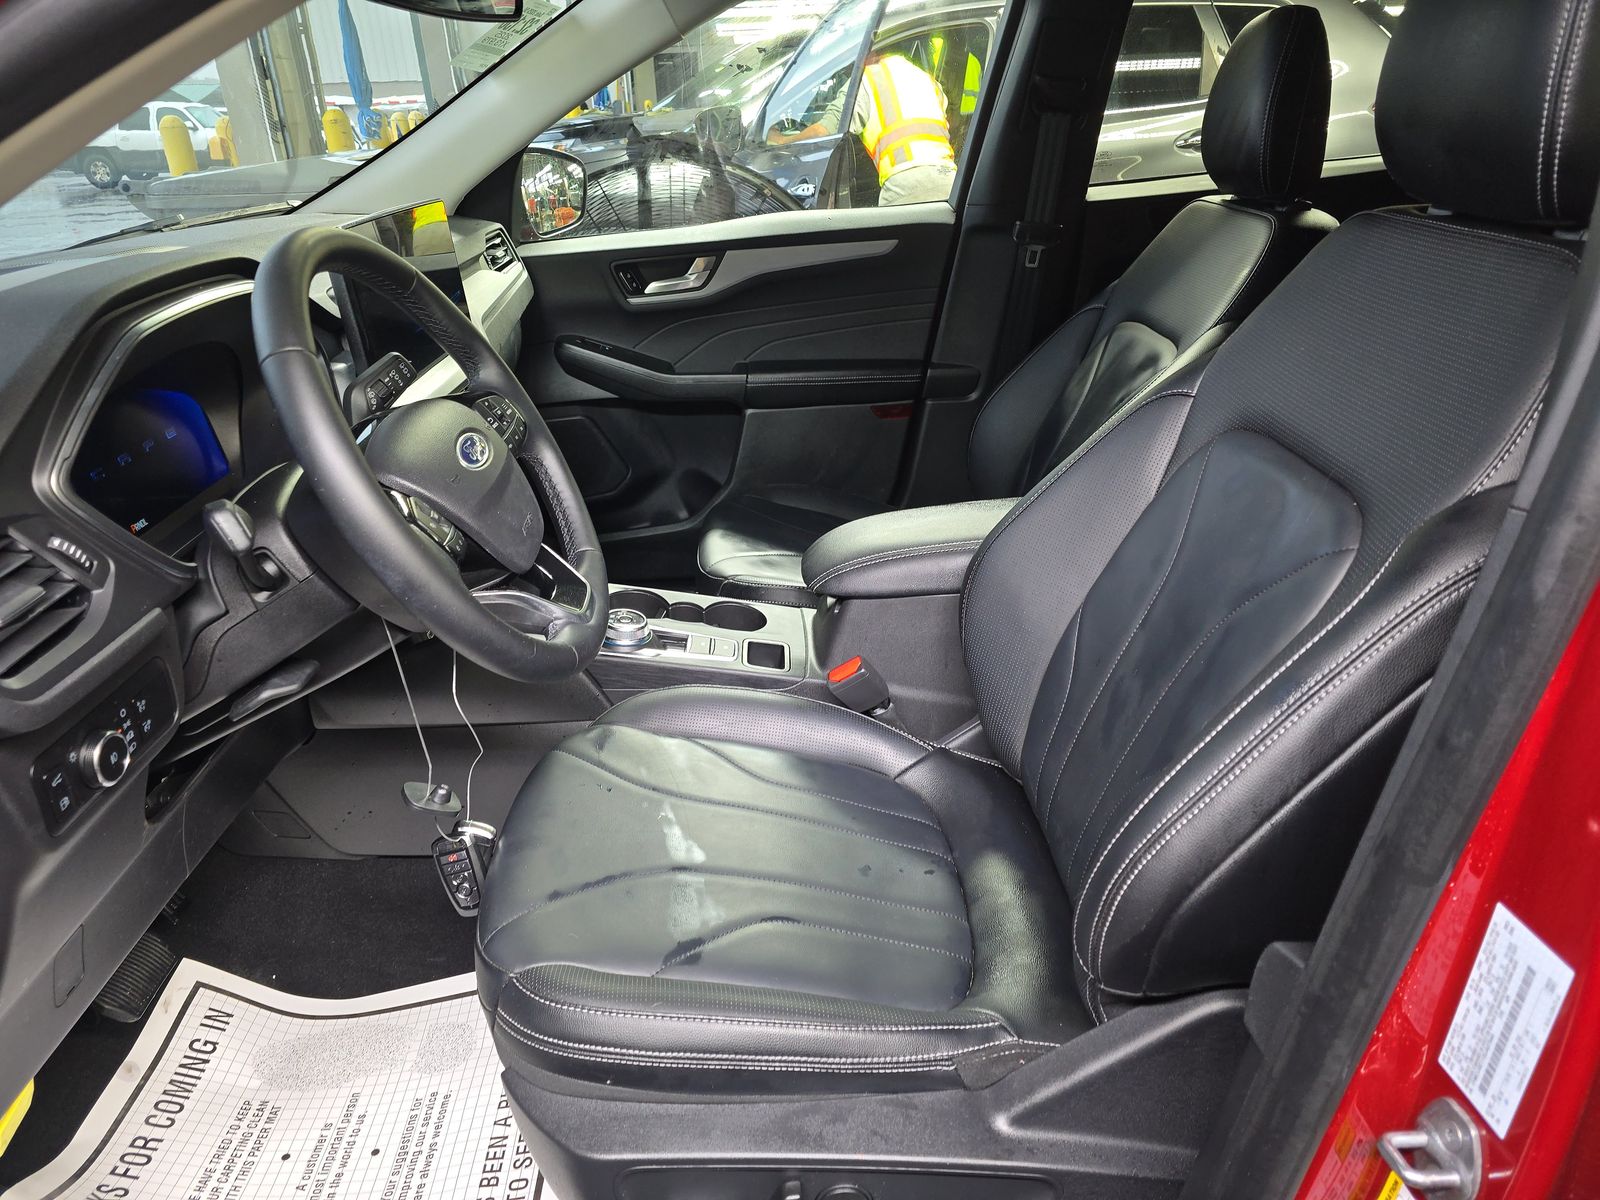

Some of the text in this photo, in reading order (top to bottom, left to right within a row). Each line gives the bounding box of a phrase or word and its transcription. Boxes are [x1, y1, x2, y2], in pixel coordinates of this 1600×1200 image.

[109, 1135, 165, 1181] FOR
[144, 1038, 219, 1129] COMING
[200, 1007, 235, 1032] IN
[415, 1130, 427, 1147] our
[421, 1091, 438, 1128] service
[194, 1167, 217, 1192] HAVE
[209, 1138, 233, 1164] TRIED
[226, 1124, 240, 1136] TO
[234, 1100, 253, 1121] KEEP
[217, 1131, 253, 1184] CARPETING
[247, 1100, 269, 1129] CLEAN
[235, 1160, 255, 1181] THIS
[248, 1127, 271, 1158] PAPER
[264, 1105, 282, 1124] MAT
[296, 1122, 333, 1192] A customer is
[318, 1126, 347, 1175] important
[341, 1092, 361, 1124] person
[329, 1172, 344, 1188] the
[339, 1140, 356, 1170] world
[349, 1128, 361, 1138] to
[355, 1110, 368, 1125] us.
[391, 1113, 418, 1176] suggestions
[410, 1098, 422, 1111] for
[420, 1141, 438, 1179] always
[432, 1089, 453, 1140] welcome.
[479, 1135, 509, 1188] BEEN
[494, 1115, 513, 1127] A
[506, 1178, 529, 1200] TO
